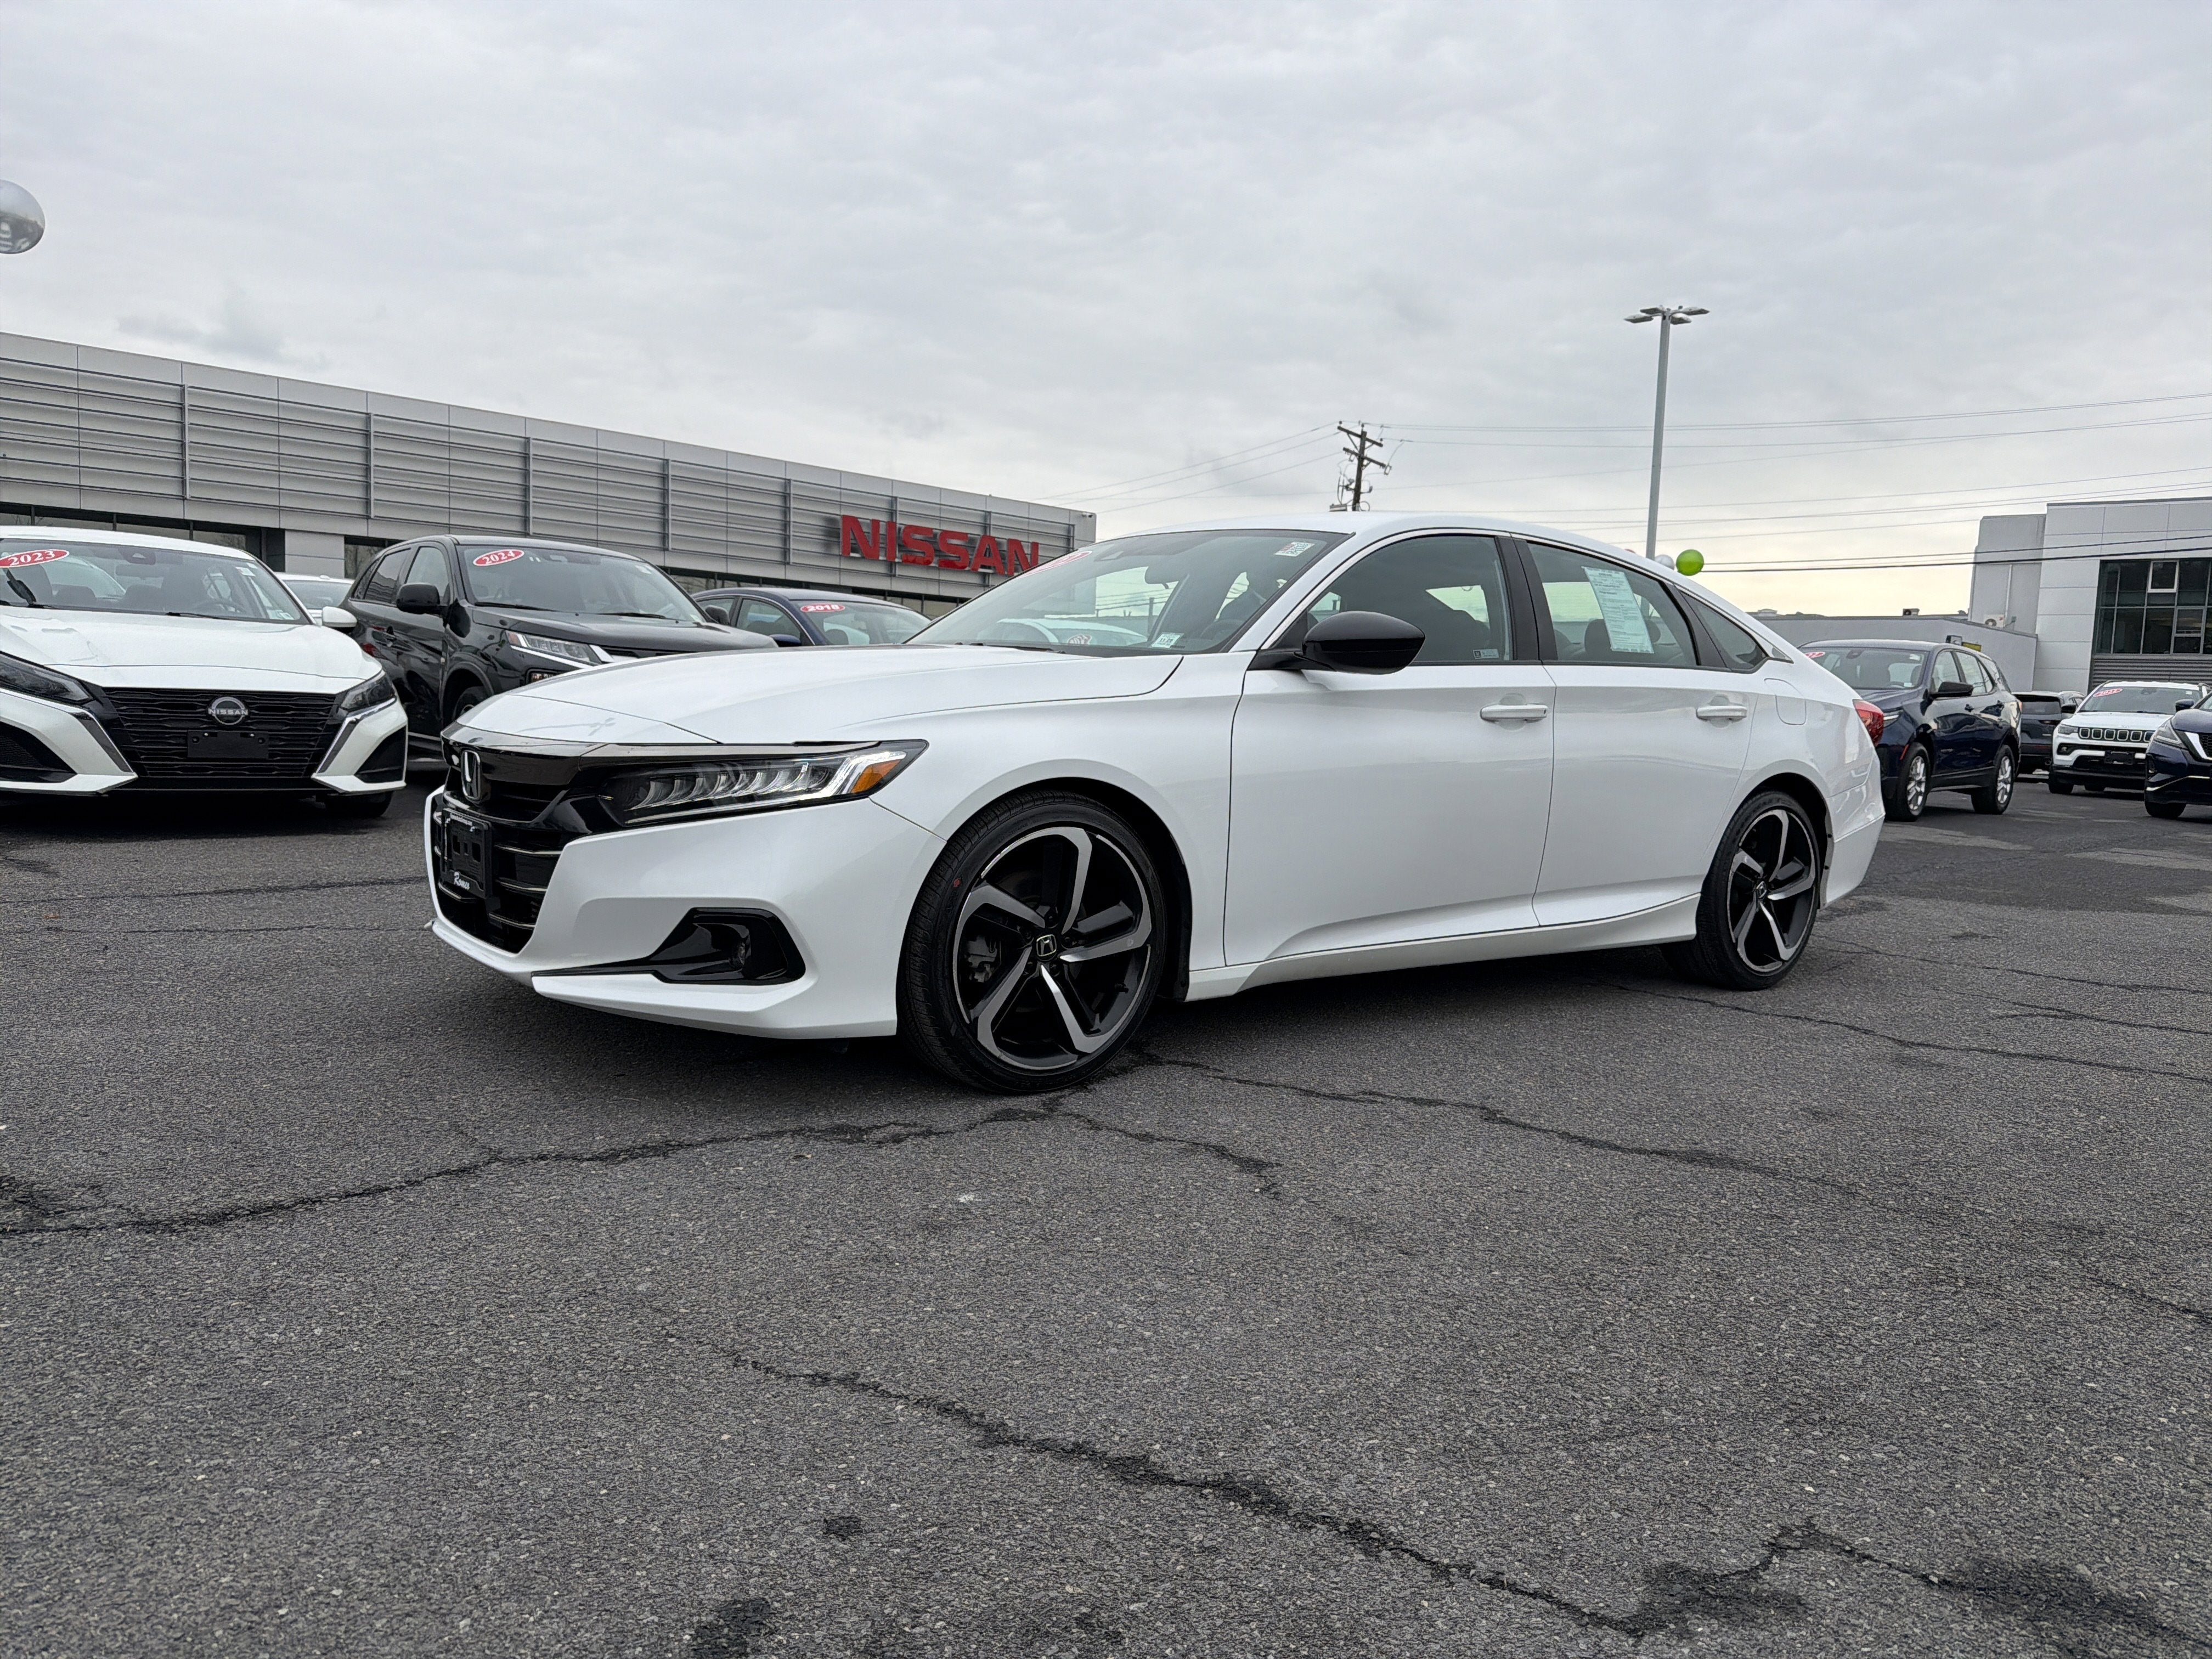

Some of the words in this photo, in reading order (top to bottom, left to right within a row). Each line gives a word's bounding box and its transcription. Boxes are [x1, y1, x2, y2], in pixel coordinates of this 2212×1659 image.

[841, 515, 1039, 575] NISSAN
[8, 550, 55, 566] 2023
[482, 550, 515, 564] 2024
